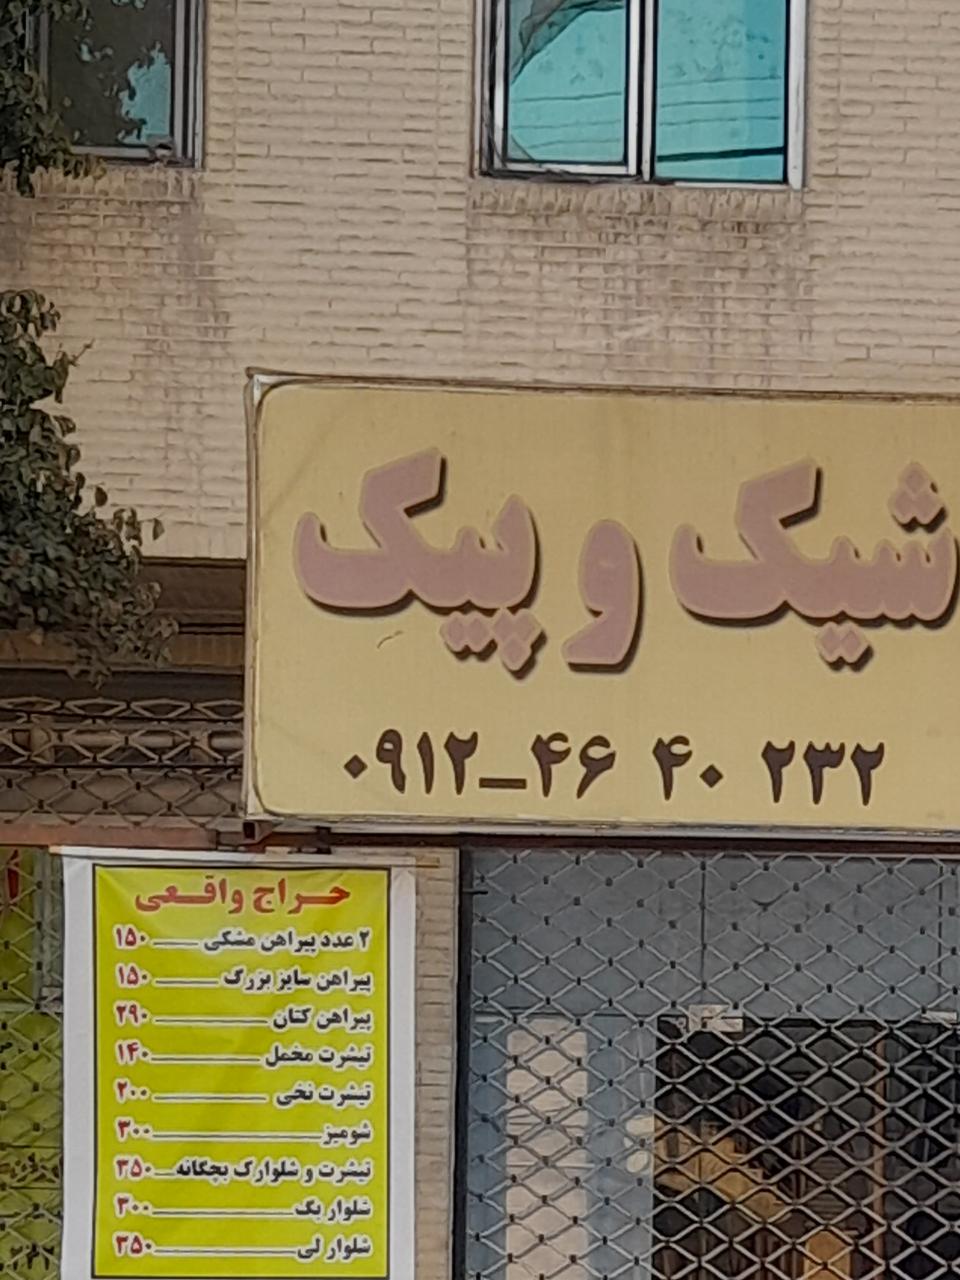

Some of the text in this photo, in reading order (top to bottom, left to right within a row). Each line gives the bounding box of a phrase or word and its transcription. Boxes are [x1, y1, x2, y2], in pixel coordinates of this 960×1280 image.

[293, 446, 546, 679] پیک
[562, 517, 645, 673] و
[135, 875, 351, 915] حراج واقعی
[115, 926, 370, 953] ۲ عدد پیراهن مشکی ۱۵۰
[118, 965, 371, 992] پیراهن سایز بزرگ ۱۵۰
[273, 1007, 311, 1029] کتان
[316, 1008, 371, 1031] پیراهن
[118, 1042, 371, 1068] تیشرت مخمل ۱۴۰
[117, 1081, 371, 1106] تیشرت نخی ۲۰۰
[118, 1119, 371, 1145] شومیز ۳۰۰
[116, 1159, 151, 1178] ۳۵۰
[233, 1159, 299, 1183] شلوارک
[304, 1167, 314, 1183] و
[318, 1160, 371, 1183] تیشرت
[117, 1197, 149, 1215] ۳۰۰
[327, 1199, 371, 1222] شلوار
[115, 1235, 371, 1260] شلوار لی ۳۵۰
